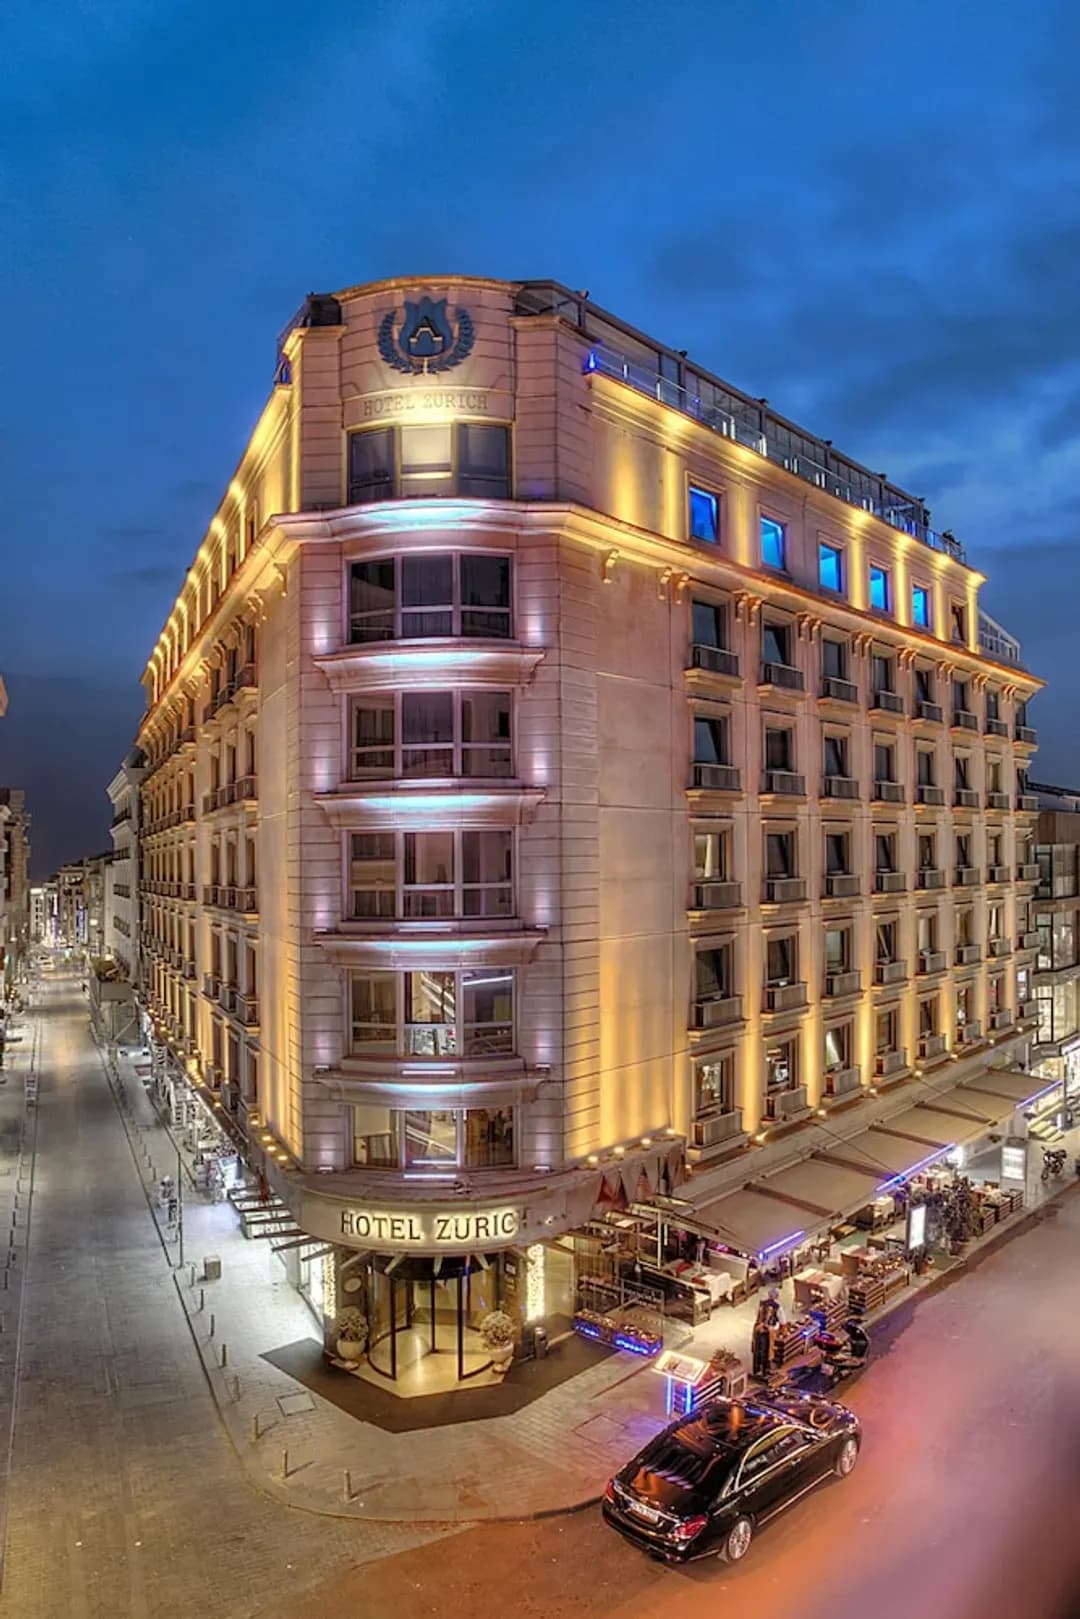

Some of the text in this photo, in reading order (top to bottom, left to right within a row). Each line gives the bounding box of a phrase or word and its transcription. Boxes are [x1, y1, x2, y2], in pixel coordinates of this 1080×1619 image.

[364, 393, 488, 416] HOTEL ZURICH
[341, 1211, 421, 1240] HOTEL
